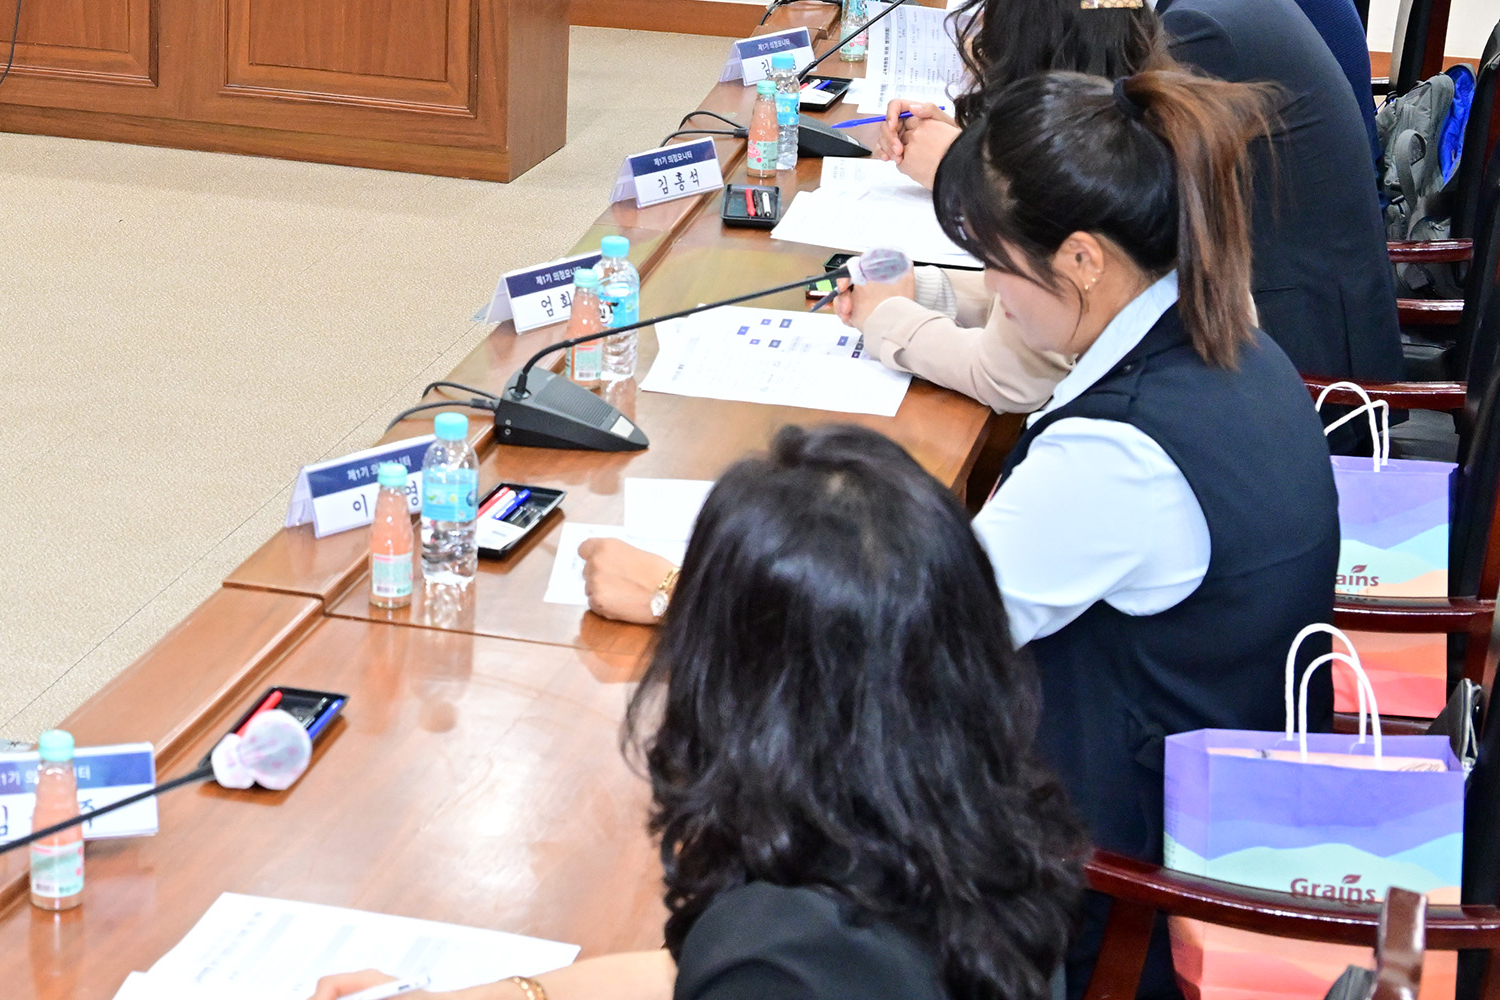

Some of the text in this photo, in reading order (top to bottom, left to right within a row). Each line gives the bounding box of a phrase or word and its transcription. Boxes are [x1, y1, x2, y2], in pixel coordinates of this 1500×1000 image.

[653, 150, 693, 167] 제1기 의정모니터
[535, 274, 553, 286] 제1기
[346, 466, 370, 482] 제1기
[1290, 876, 1376, 903] Grains
